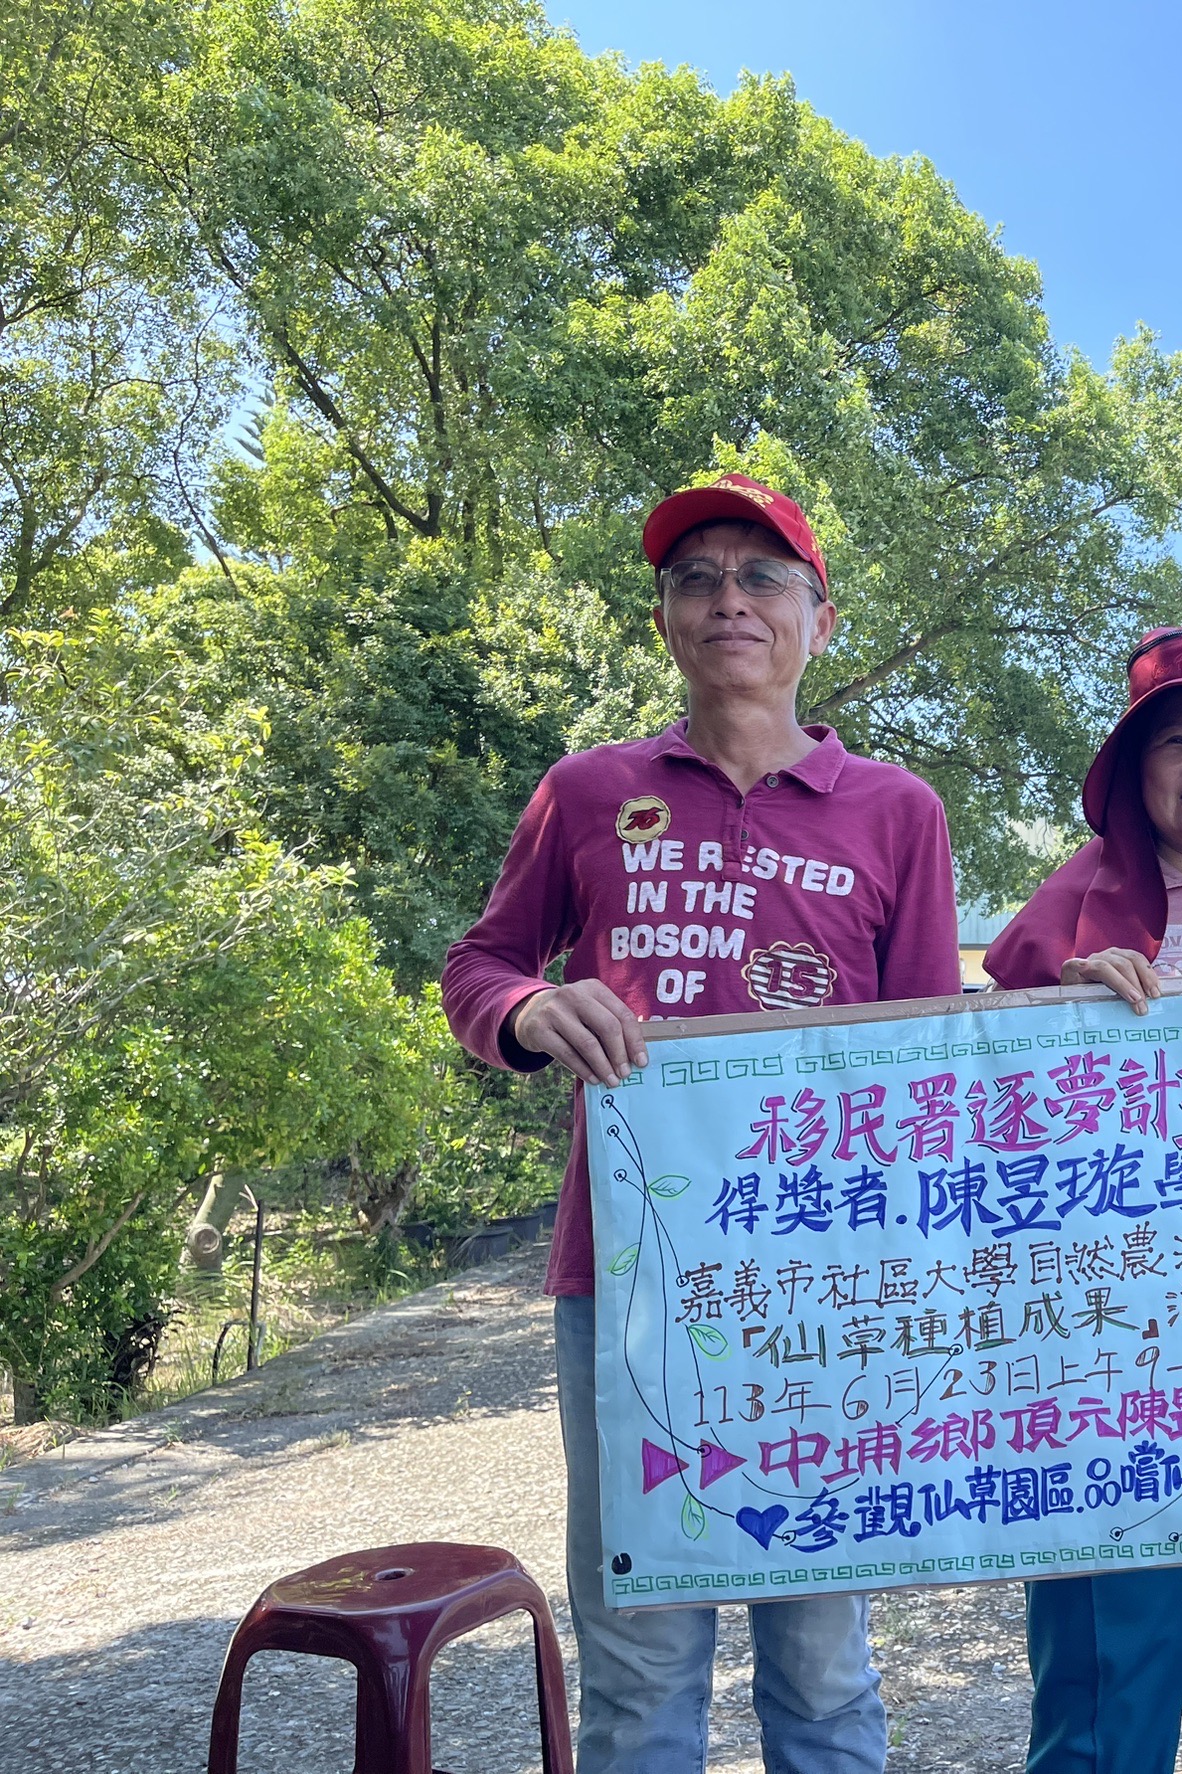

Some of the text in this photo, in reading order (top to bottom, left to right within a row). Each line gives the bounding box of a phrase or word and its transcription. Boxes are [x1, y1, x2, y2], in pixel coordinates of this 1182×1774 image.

[622, 838, 685, 873] WE
[626, 880, 757, 920] IN THE
[611, 923, 746, 961] BOSOM
[656, 969, 706, 1004] OF
[767, 960, 818, 998] 15
